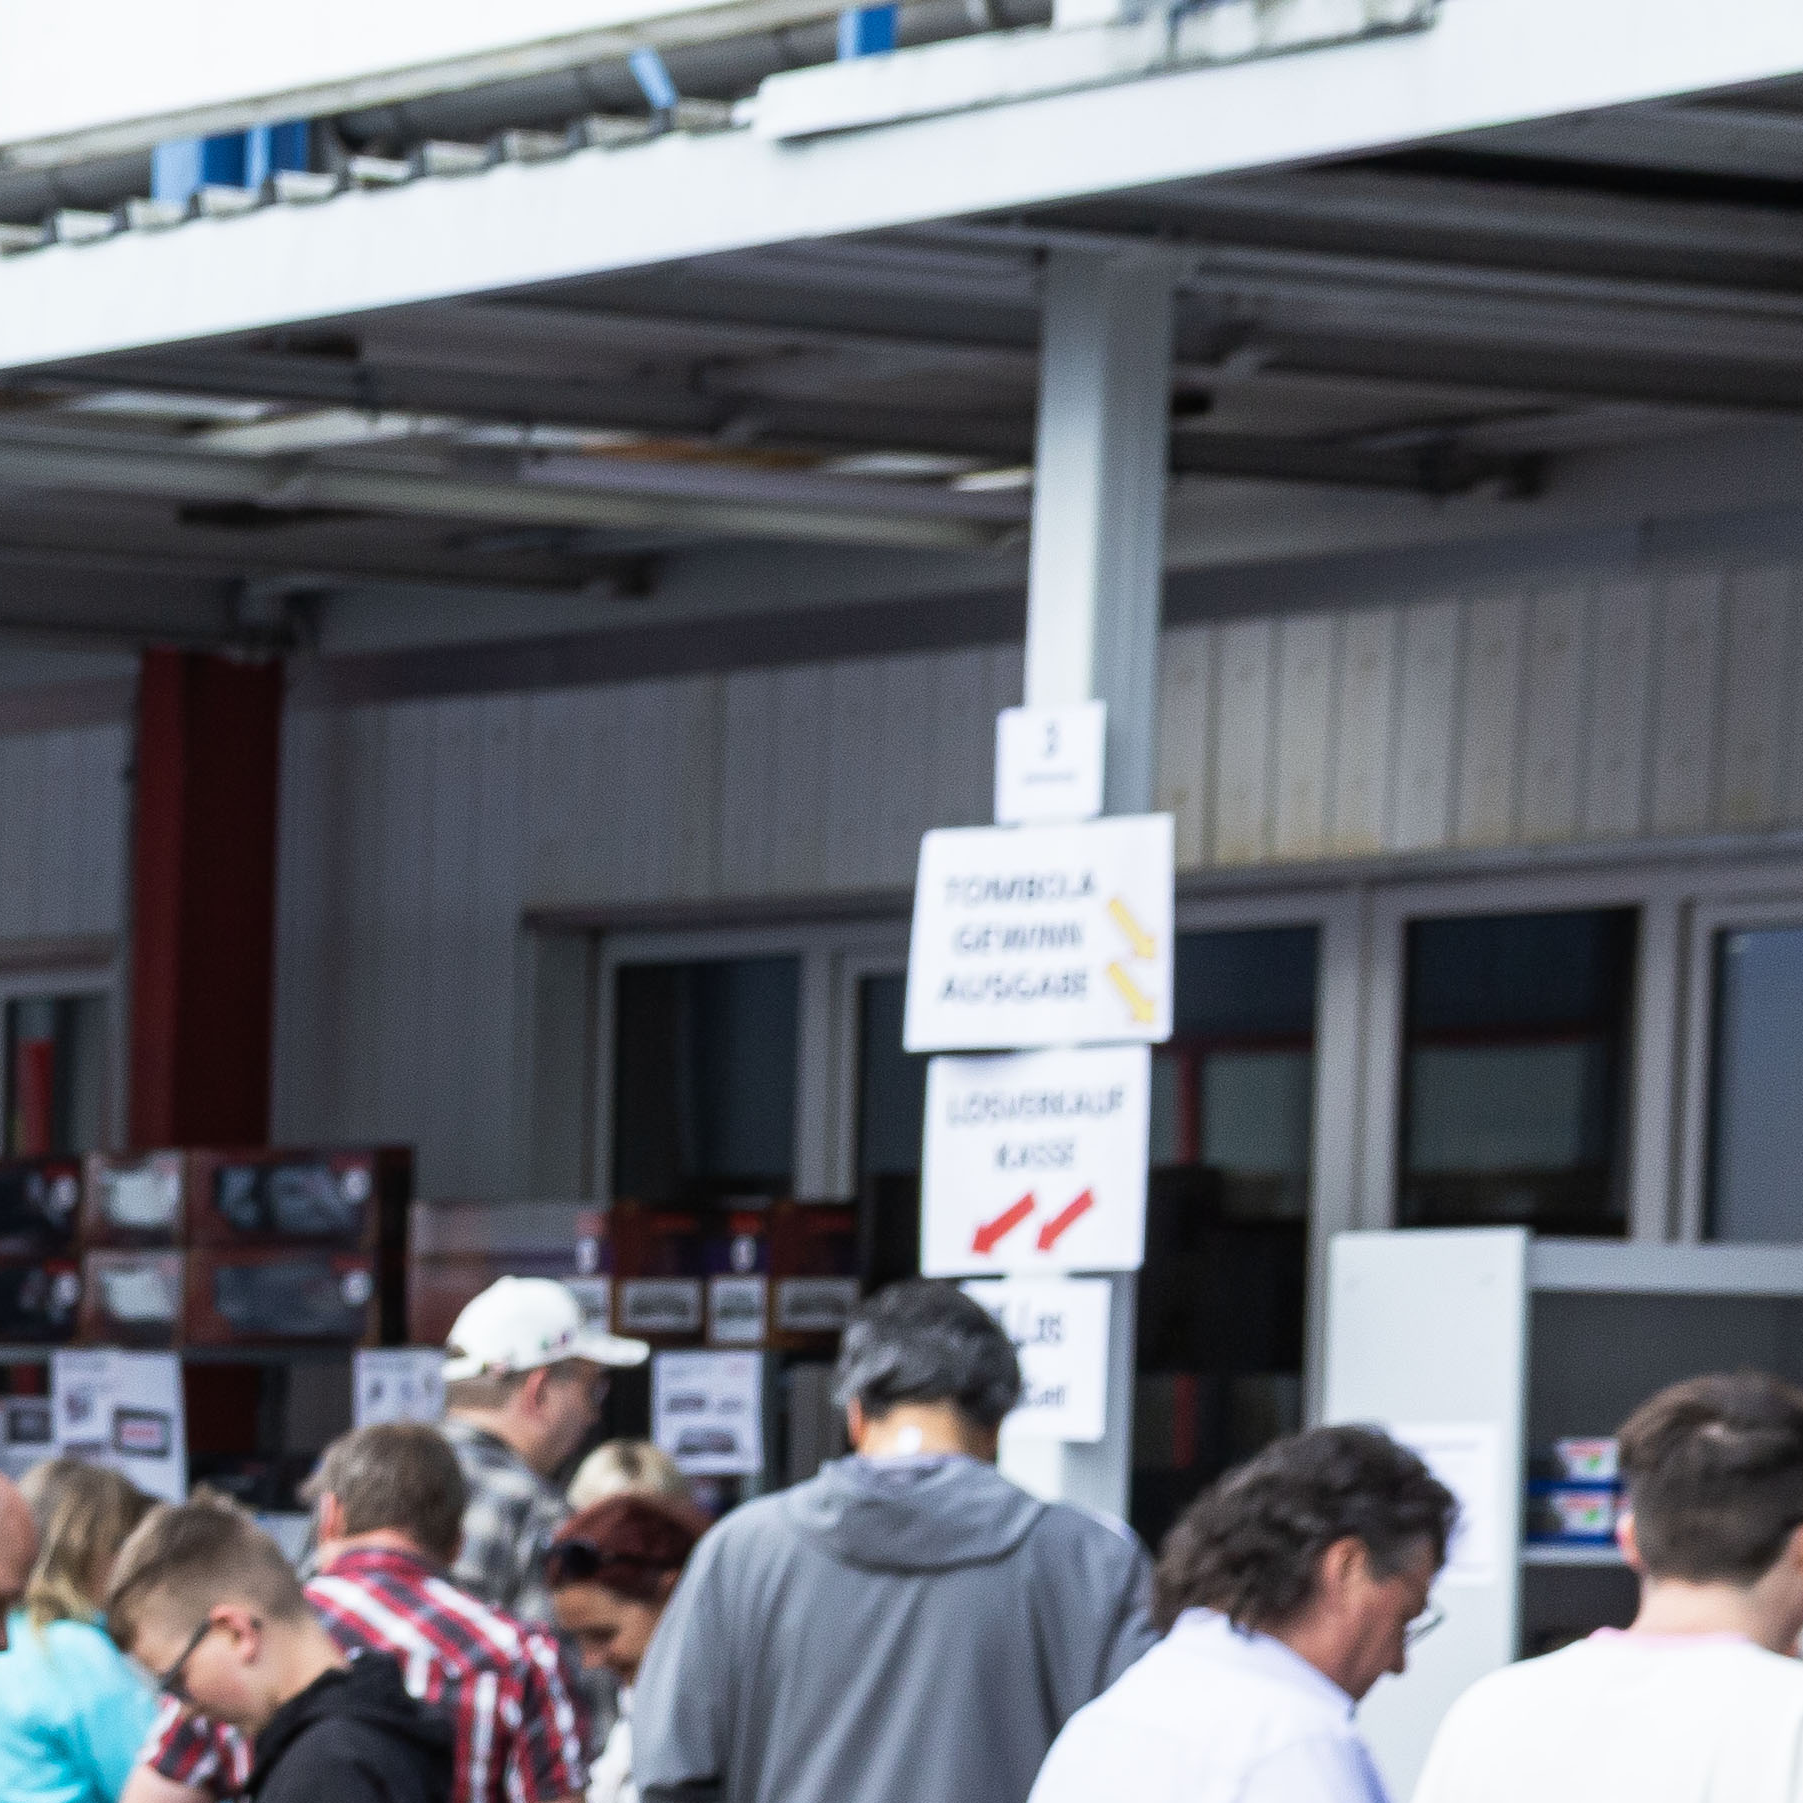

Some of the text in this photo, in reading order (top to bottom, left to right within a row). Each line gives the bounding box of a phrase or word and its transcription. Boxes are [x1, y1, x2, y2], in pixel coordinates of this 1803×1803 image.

[945, 871, 1097, 906] TOMBOLA
[954, 920, 1082, 954] GEWINN
[941, 968, 1086, 1001] AUSGABE
[996, 1140, 1076, 1169] KASSE
